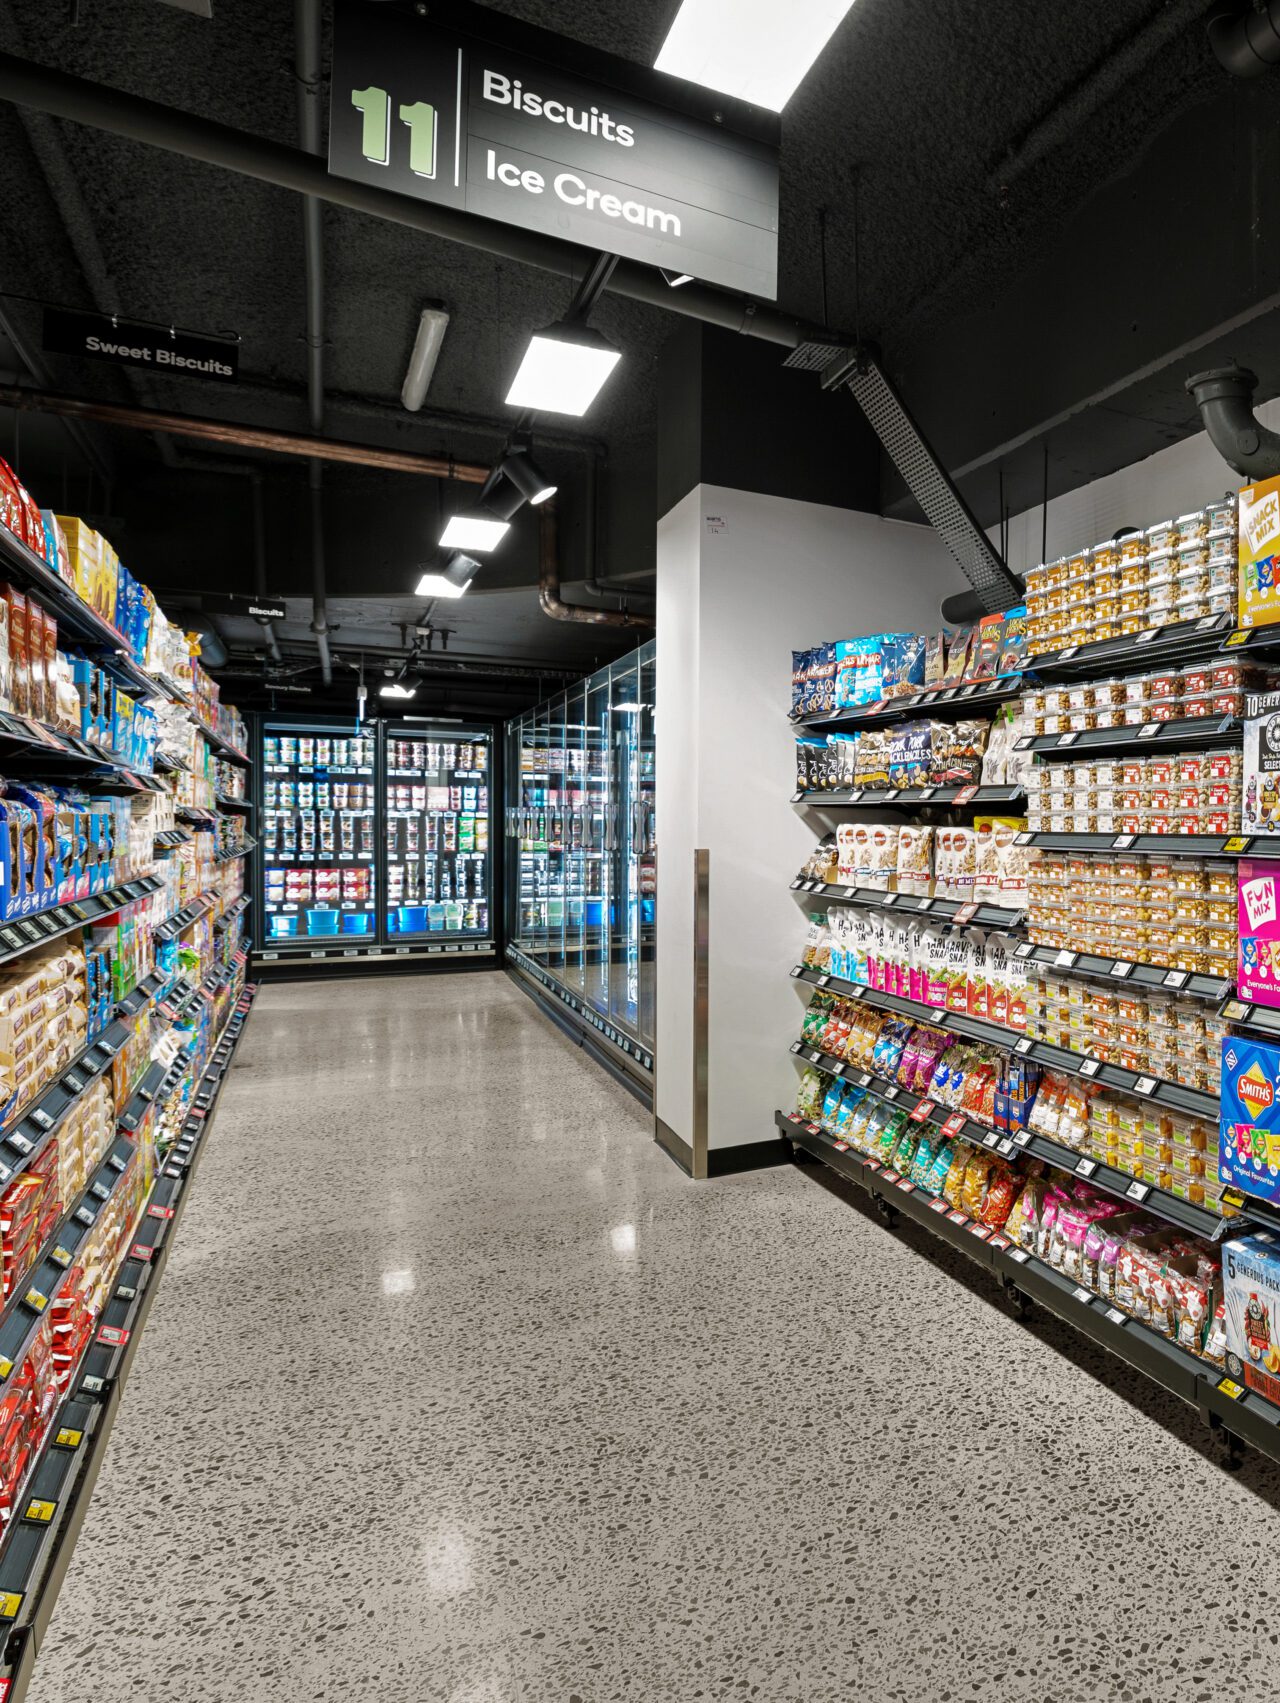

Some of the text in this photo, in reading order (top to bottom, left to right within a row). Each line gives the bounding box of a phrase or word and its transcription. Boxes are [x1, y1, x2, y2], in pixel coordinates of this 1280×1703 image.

[484, 70, 635, 147] Biscuits
[352, 87, 438, 179] 11
[487, 150, 680, 237] Ice Cream
[86, 336, 232, 376] Sweet Biscuits
[249, 607, 283, 616] Biscuits
[1234, 1165, 1250, 1179] Original
[1228, 1256, 1236, 1279] 5
[1237, 1265, 1264, 1286] GENEROUS
